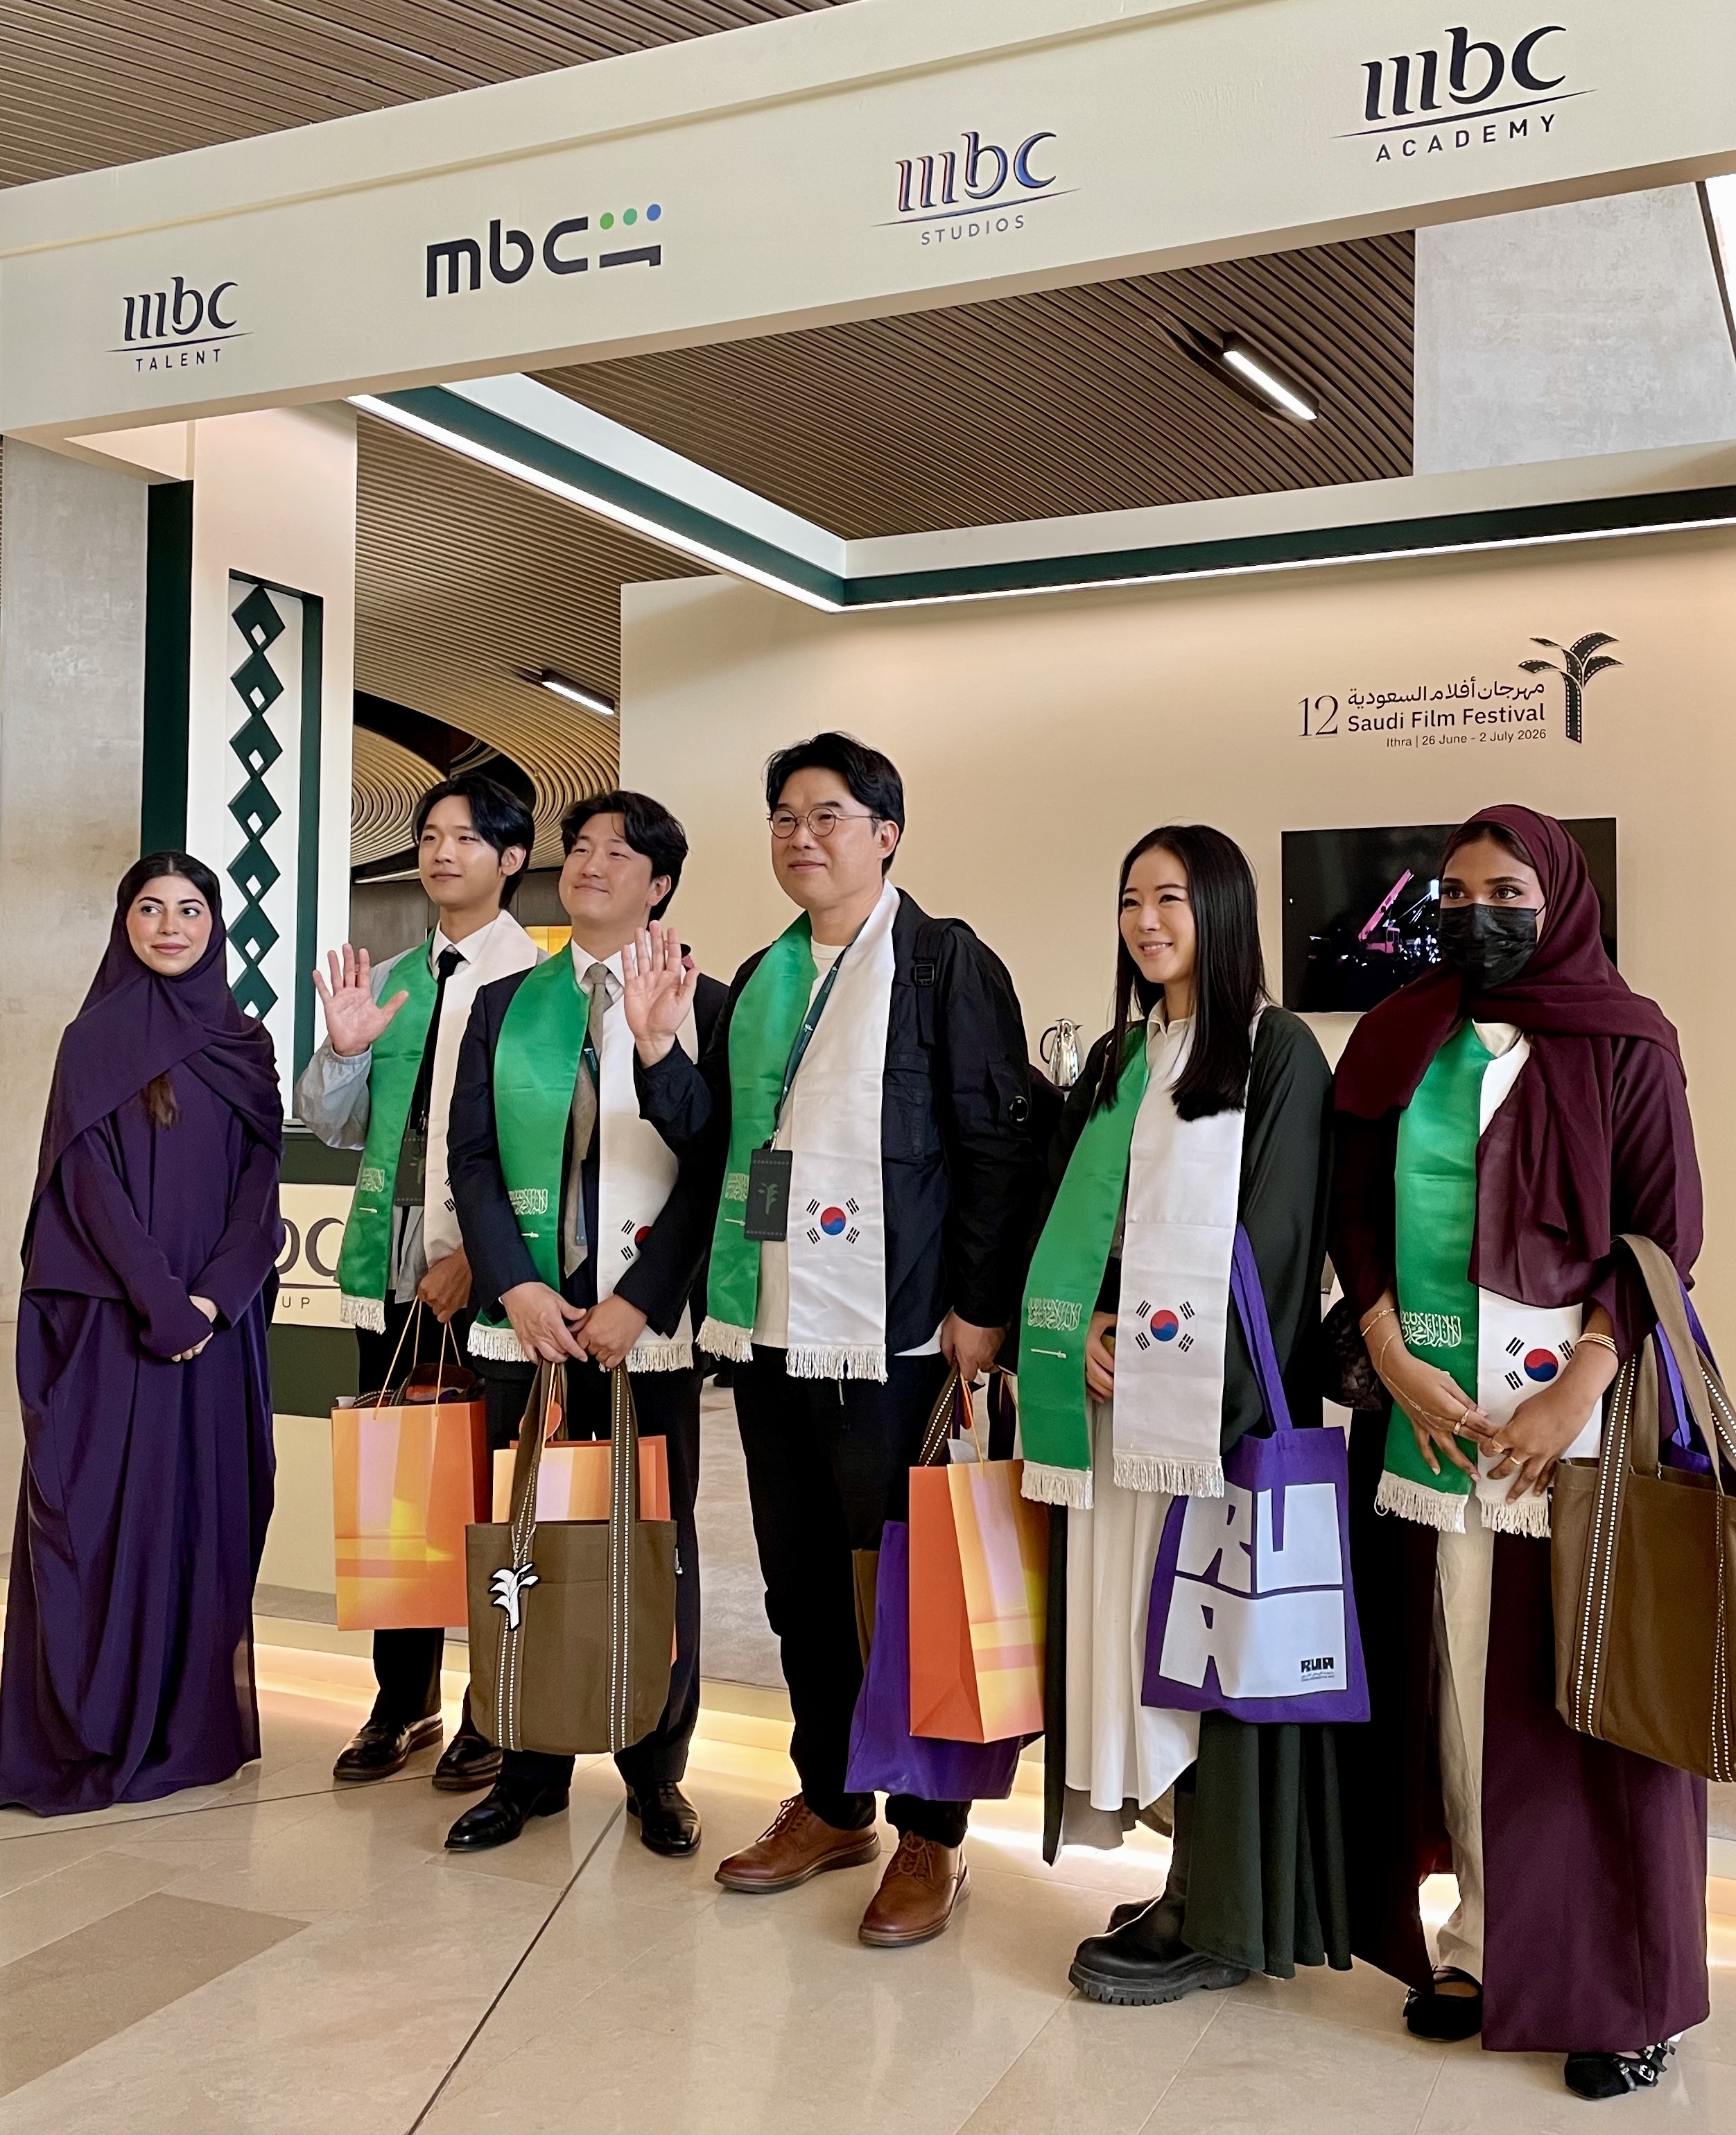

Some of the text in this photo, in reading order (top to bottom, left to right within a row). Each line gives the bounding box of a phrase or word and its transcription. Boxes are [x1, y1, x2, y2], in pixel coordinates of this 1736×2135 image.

[1360, 25, 1567, 121] mbc
[1375, 113, 1556, 163] ACADEMY
[894, 131, 1057, 213] mbc
[921, 214, 1025, 245] STUDIOS
[122, 276, 238, 342] mbc
[135, 348, 221, 372] TALENT
[1348, 675, 1545, 709] مهرجان أفلام السعودية
[1298, 695, 1339, 737] 12
[1348, 702, 1545, 732] Saudi Film Festival
[1387, 737, 1412, 747] Ithra
[1422, 735, 1436, 745] 26
[1439, 734, 1468, 745] June
[1479, 732, 1486, 742] 2
[1489, 730, 1514, 743] July
[1518, 728, 1547, 740] 2026
[1301, 1657, 1335, 1672] RUA
